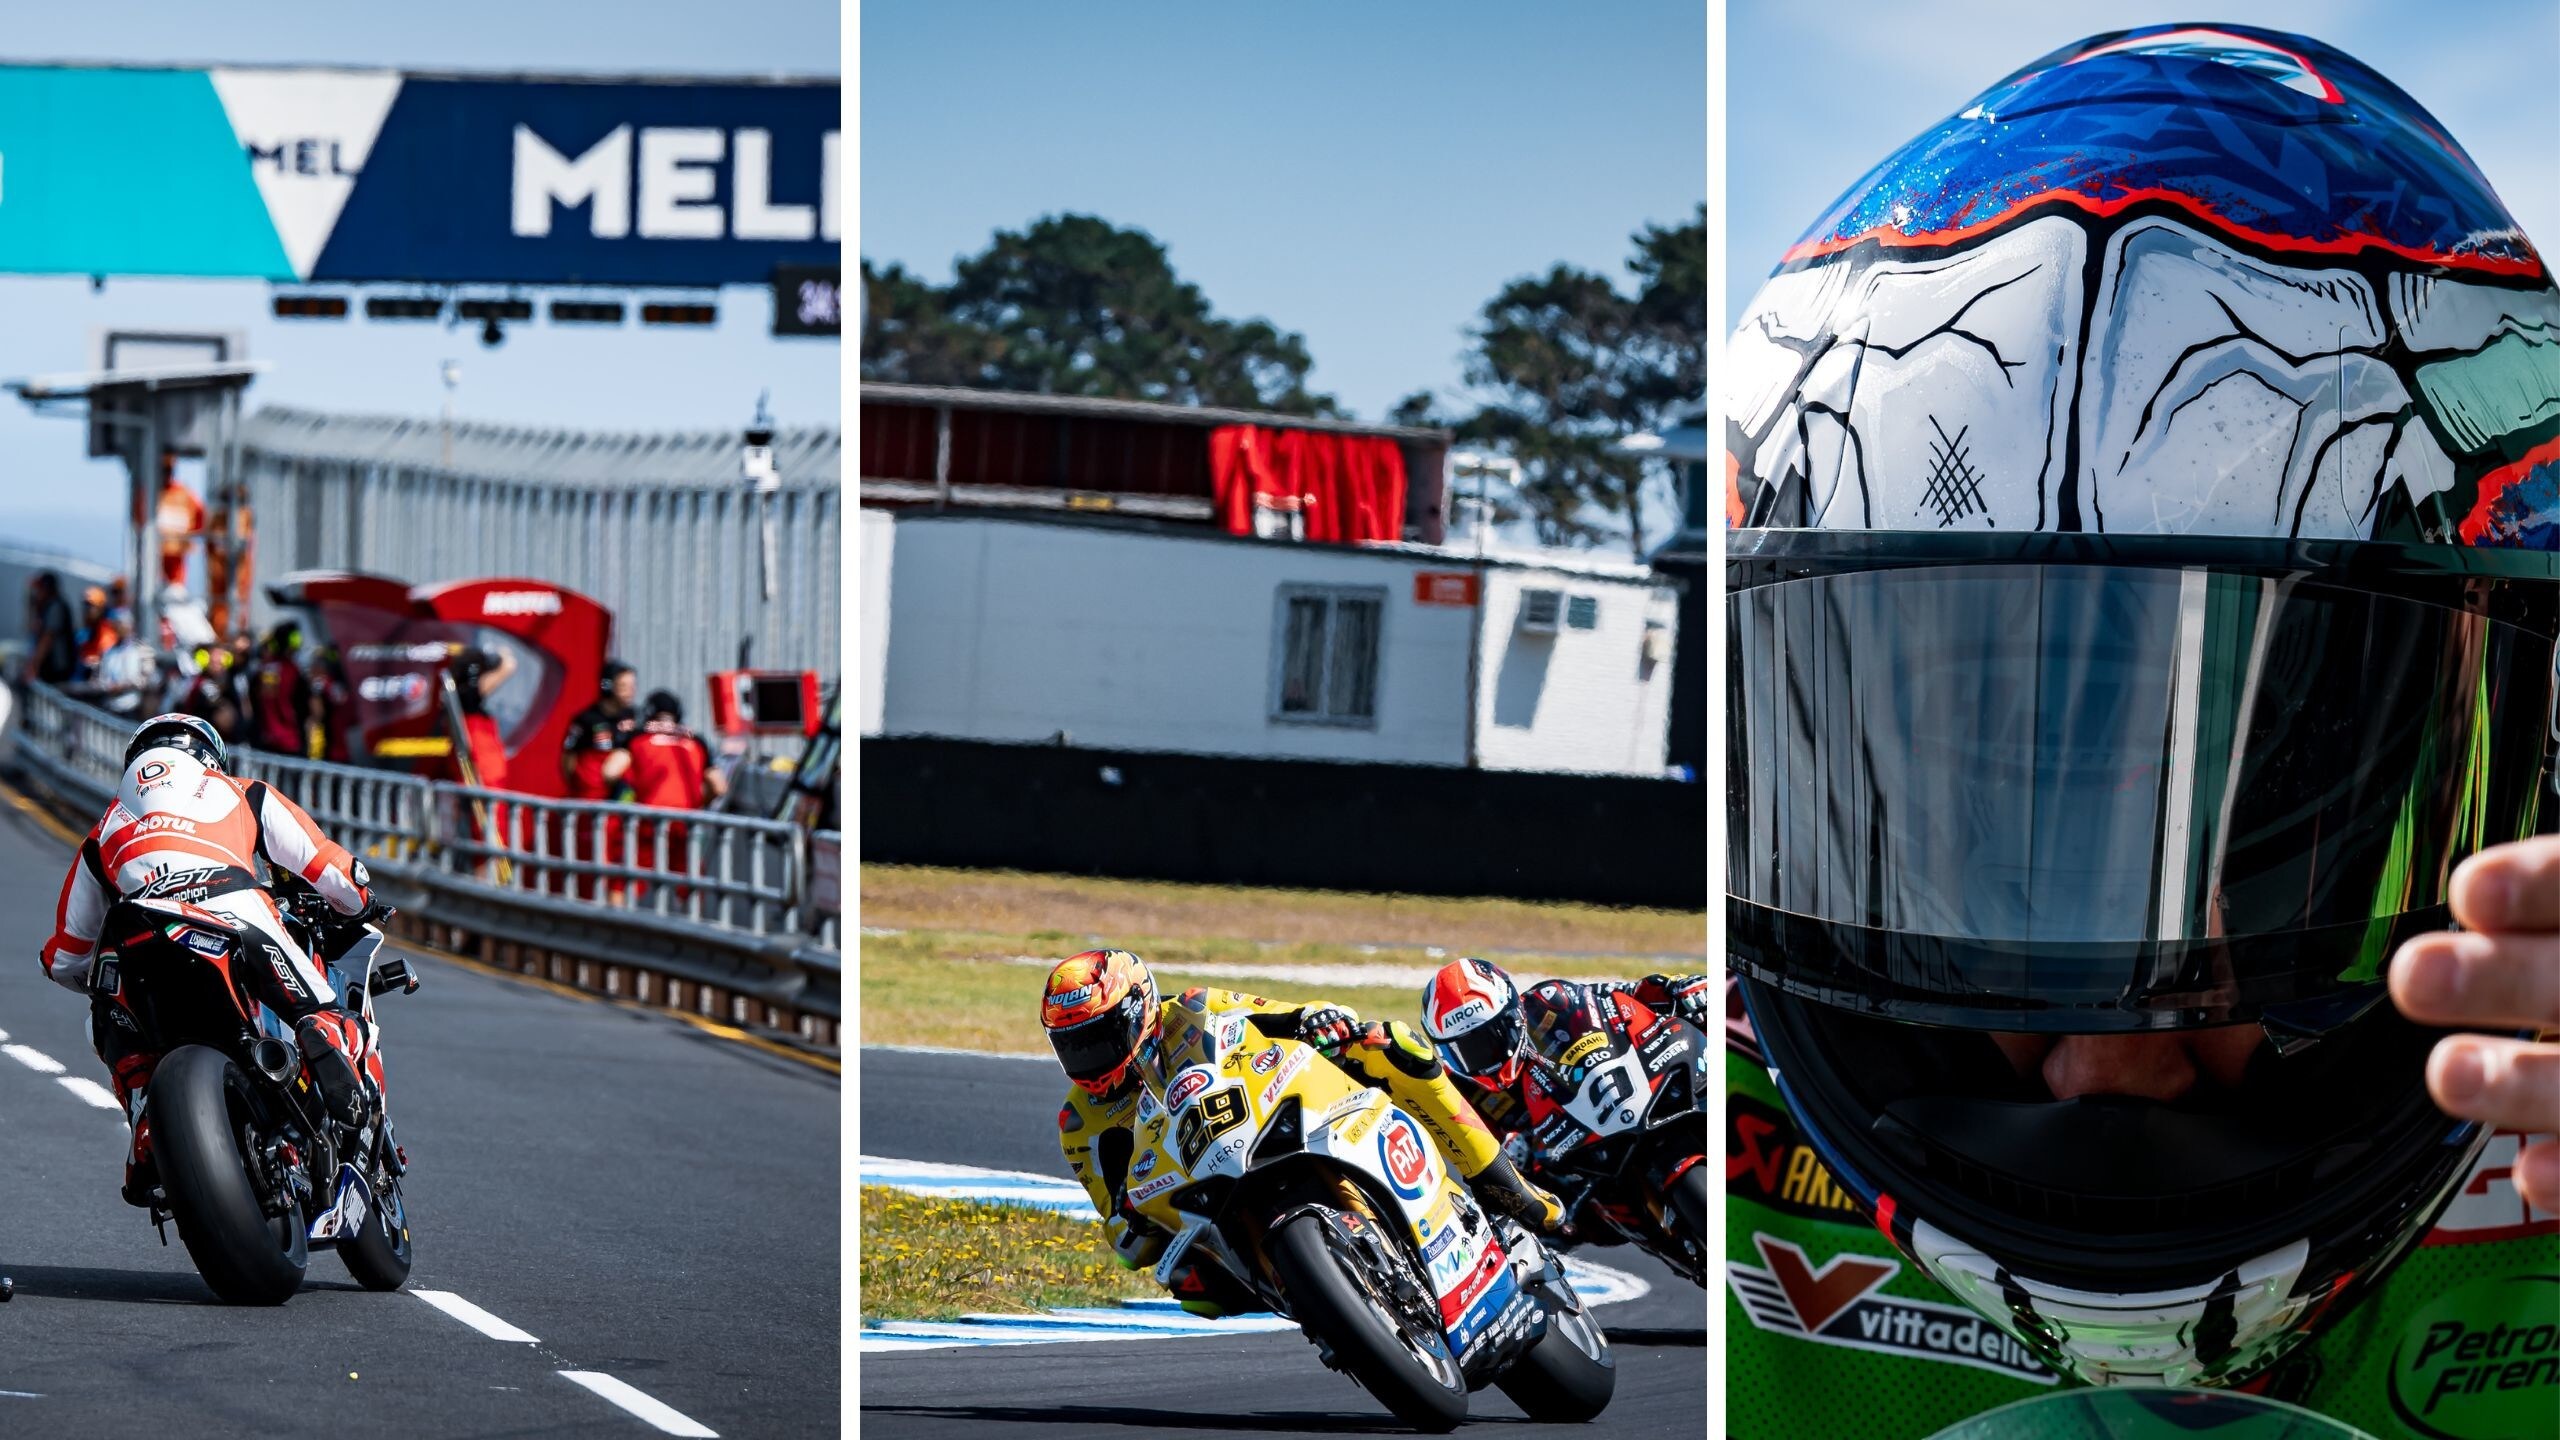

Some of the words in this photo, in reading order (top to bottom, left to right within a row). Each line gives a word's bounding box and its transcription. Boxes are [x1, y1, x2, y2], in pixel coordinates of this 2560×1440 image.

[246, 138, 362, 176] MEL
[511, 123, 841, 241] MEL
[133, 815, 197, 836] MOTUL
[262, 943, 308, 998] RST
[1047, 983, 1094, 1009] NOLAN
[1444, 1001, 1485, 1029] AIROH
[1566, 1036, 1603, 1062] BARDAHL
[1643, 1027, 1672, 1054] NEXT
[1584, 1050, 1611, 1068] dto
[1171, 1076, 1202, 1107] PATA
[1264, 1048, 1307, 1105] VIGNALI
[1176, 1085, 1250, 1178] 29
[1542, 1119, 1567, 1145] NEXT
[1208, 1138, 1245, 1172] HERO
[2411, 1320, 2559, 1372] Petro
[2421, 1356, 2559, 1416] Firen
